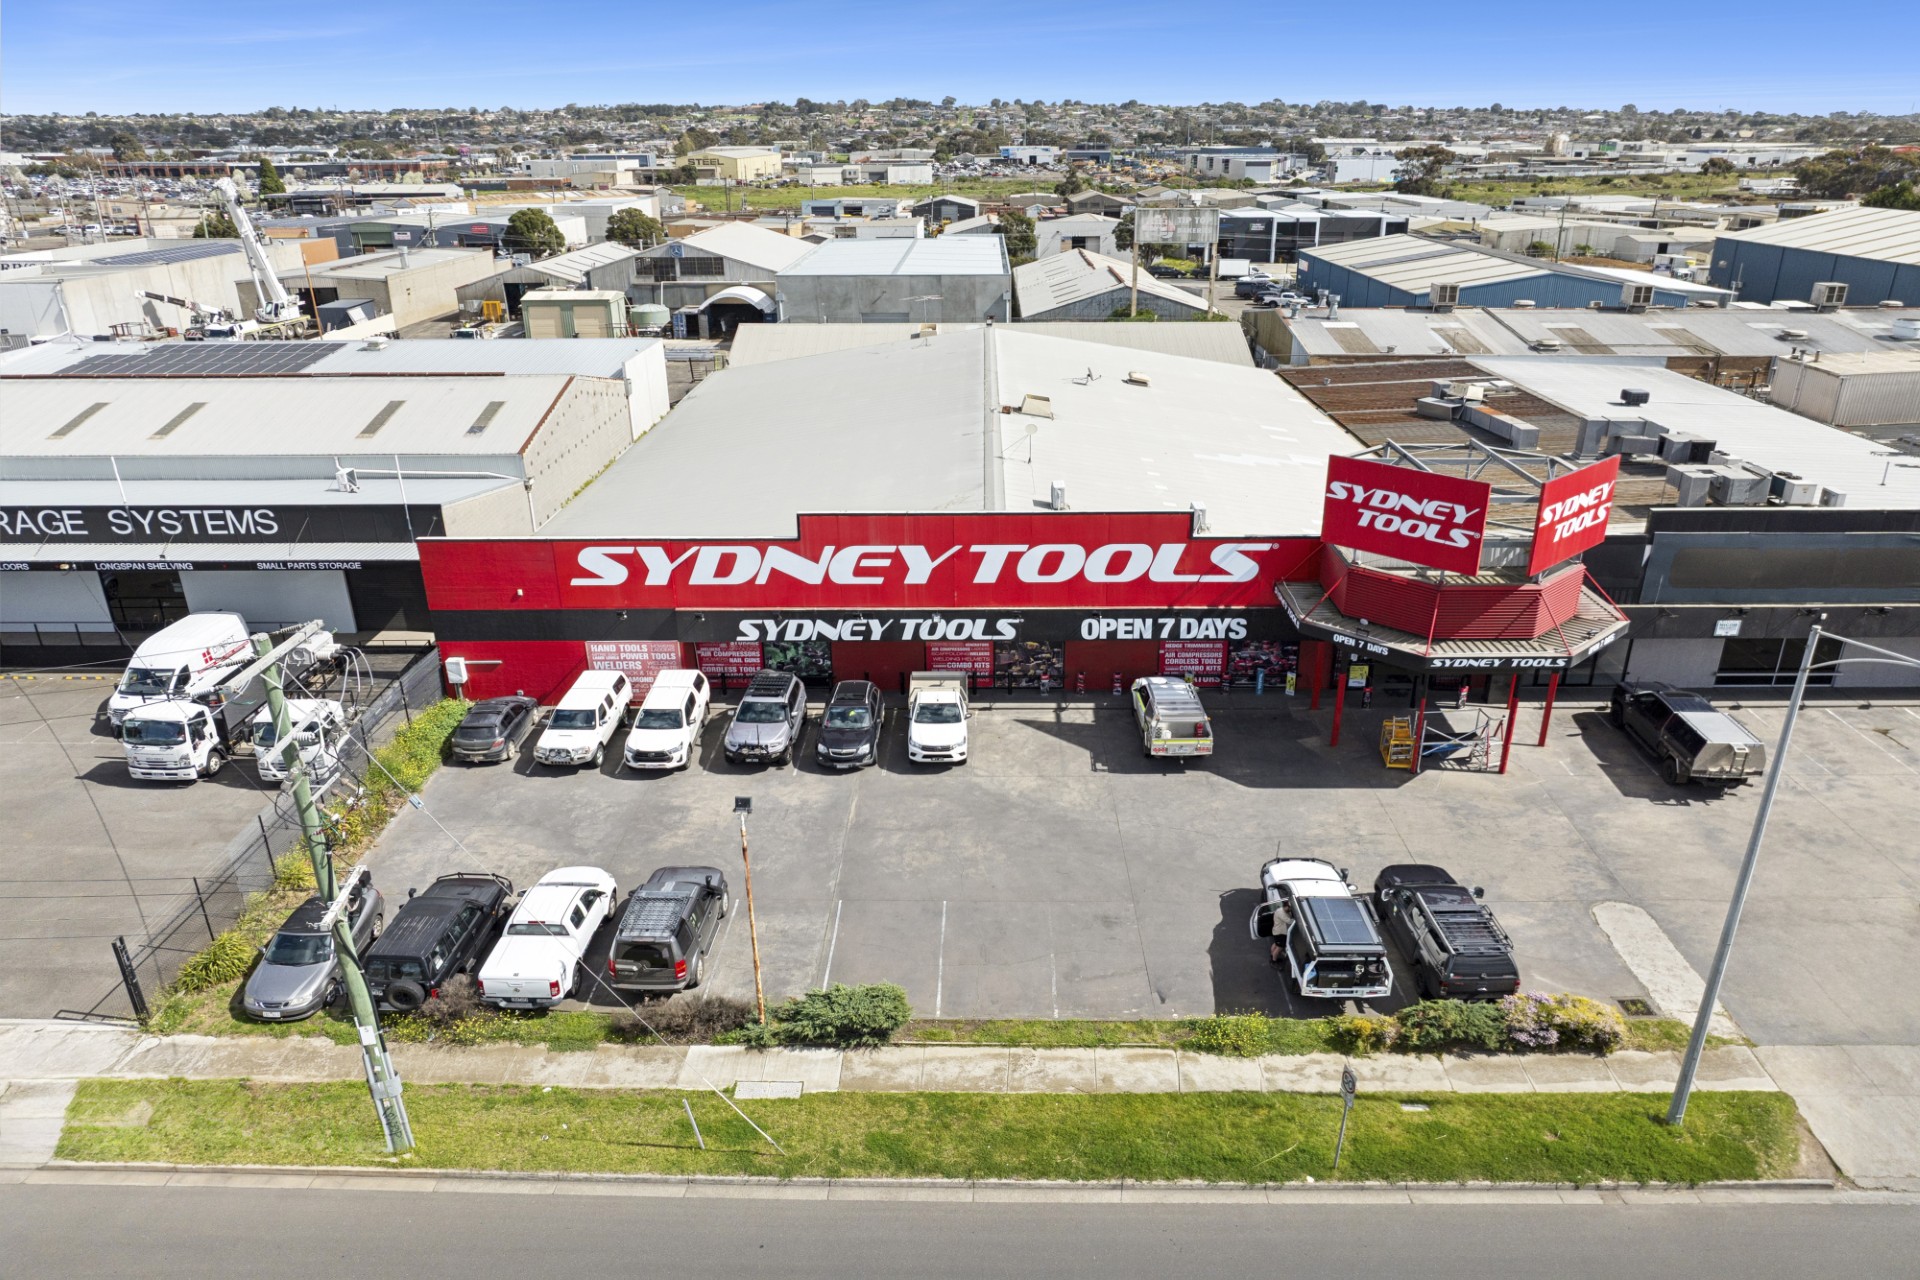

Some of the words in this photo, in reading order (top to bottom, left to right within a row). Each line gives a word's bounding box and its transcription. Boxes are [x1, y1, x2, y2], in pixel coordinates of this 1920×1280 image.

[1326, 481, 1480, 524] SYDNEY
[1539, 480, 1615, 528] SYDNEY
[107, 509, 279, 535] SYSTEMS
[1553, 501, 1612, 543] TOOLS
[256, 562, 286, 570] SMALL
[287, 562, 317, 570] PARTS
[318, 562, 362, 570] STORAGE
[570, 545, 963, 586] SYDNEY
[969, 543, 1272, 583] TOOLS
[736, 618, 894, 641] SYDNEY
[900, 617, 1019, 640] TOOLS
[1080, 617, 1152, 640] OPEN
[1157, 617, 1175, 639] 7
[1180, 616, 1247, 639] DAYS
[591, 644, 616, 652] HAND
[619, 644, 647, 652] TOOLS
[1333, 633, 1356, 646] OPEN
[1358, 640, 1365, 648] 7
[1367, 643, 1389, 655] DAYS
[593, 661, 642, 670] WELDERS
[1430, 658, 1506, 667] SYDNEY
[1511, 658, 1568, 667] TOOLS
